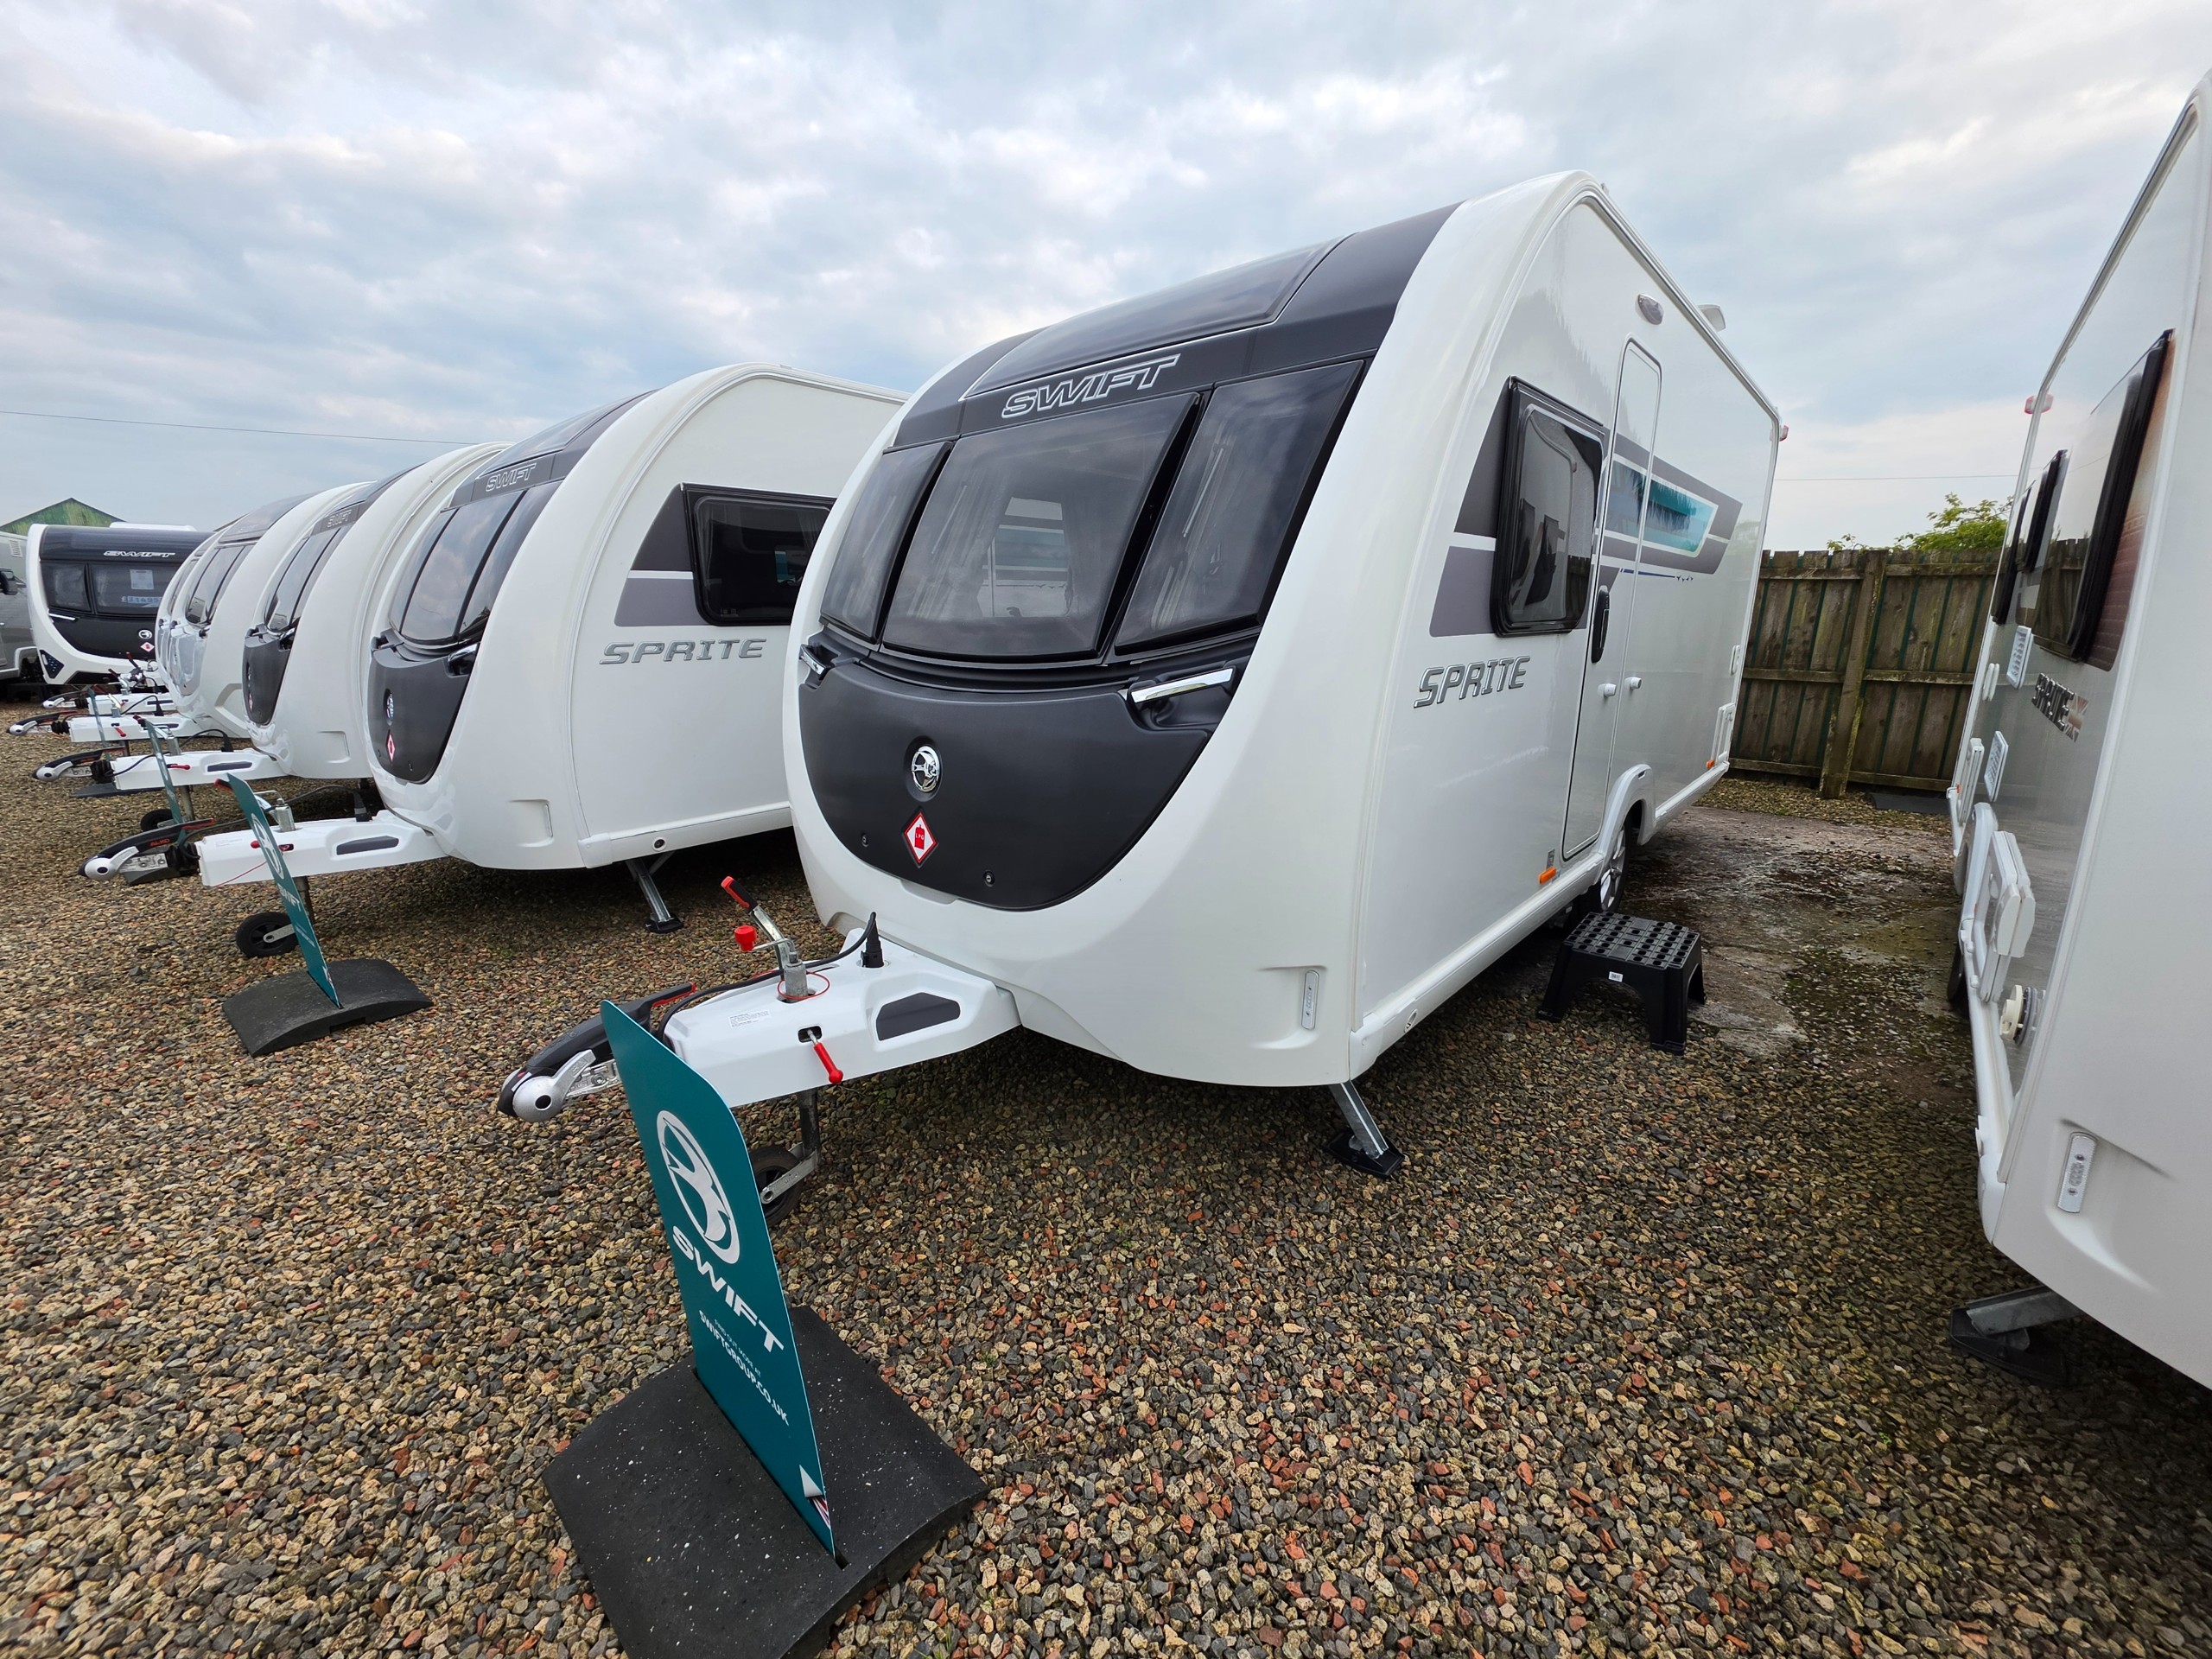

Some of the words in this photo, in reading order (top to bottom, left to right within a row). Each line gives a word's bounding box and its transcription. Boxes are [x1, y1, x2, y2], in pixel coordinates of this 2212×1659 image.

[1001, 353, 1181, 418] SWIFT
[486, 462, 537, 492] SWIFT
[327, 509, 352, 528] SWIFT
[599, 638, 767, 664] SPRITE
[1413, 655, 1531, 709] SPRITE
[915, 832, 925, 841] LPG
[672, 1225, 785, 1353] SWIFT
